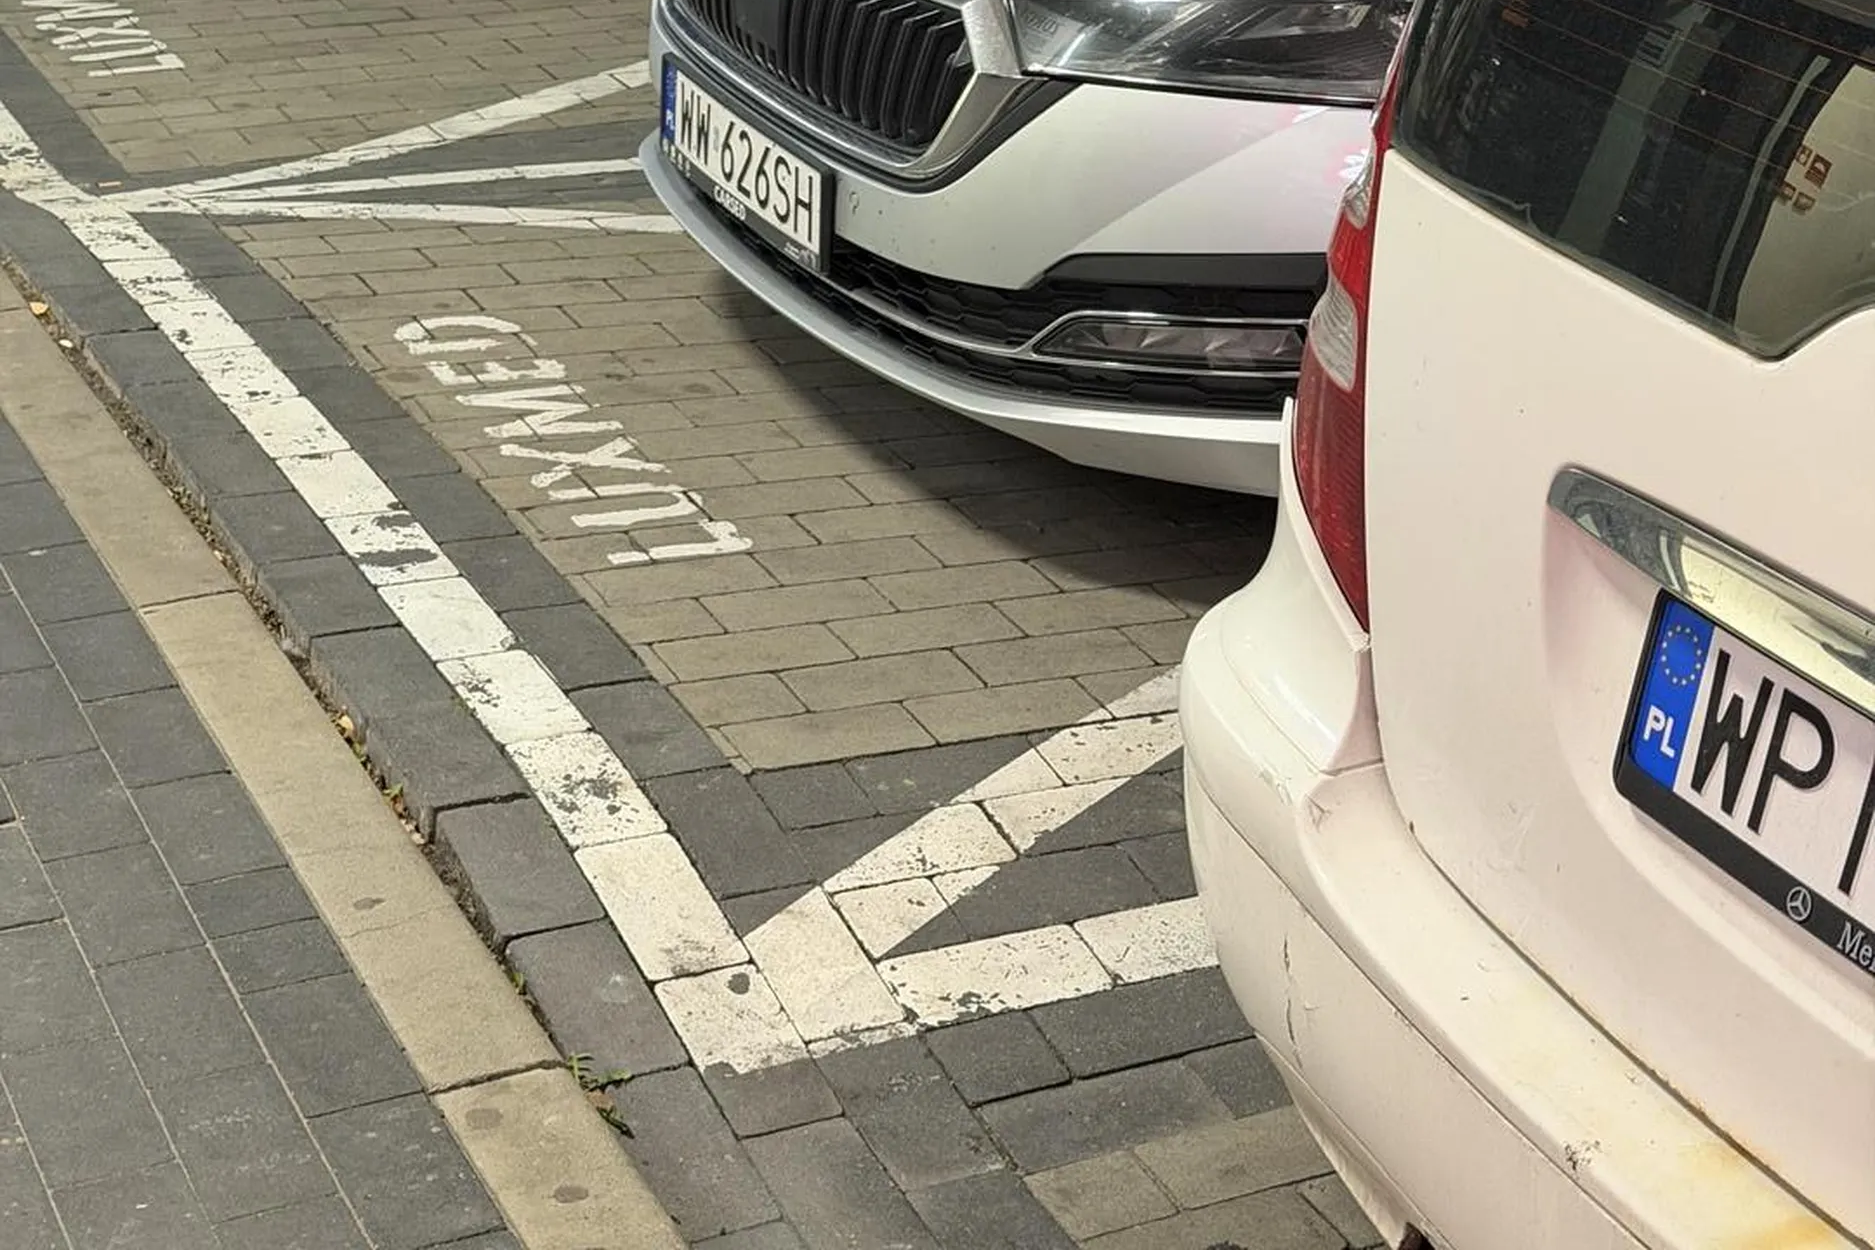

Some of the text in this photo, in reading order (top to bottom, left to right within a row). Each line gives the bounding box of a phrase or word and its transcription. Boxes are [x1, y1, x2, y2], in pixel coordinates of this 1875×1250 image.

[680, 81, 813, 243] WW 626SH
[1643, 704, 1675, 758] PL
[1691, 648, 1835, 835] WP
